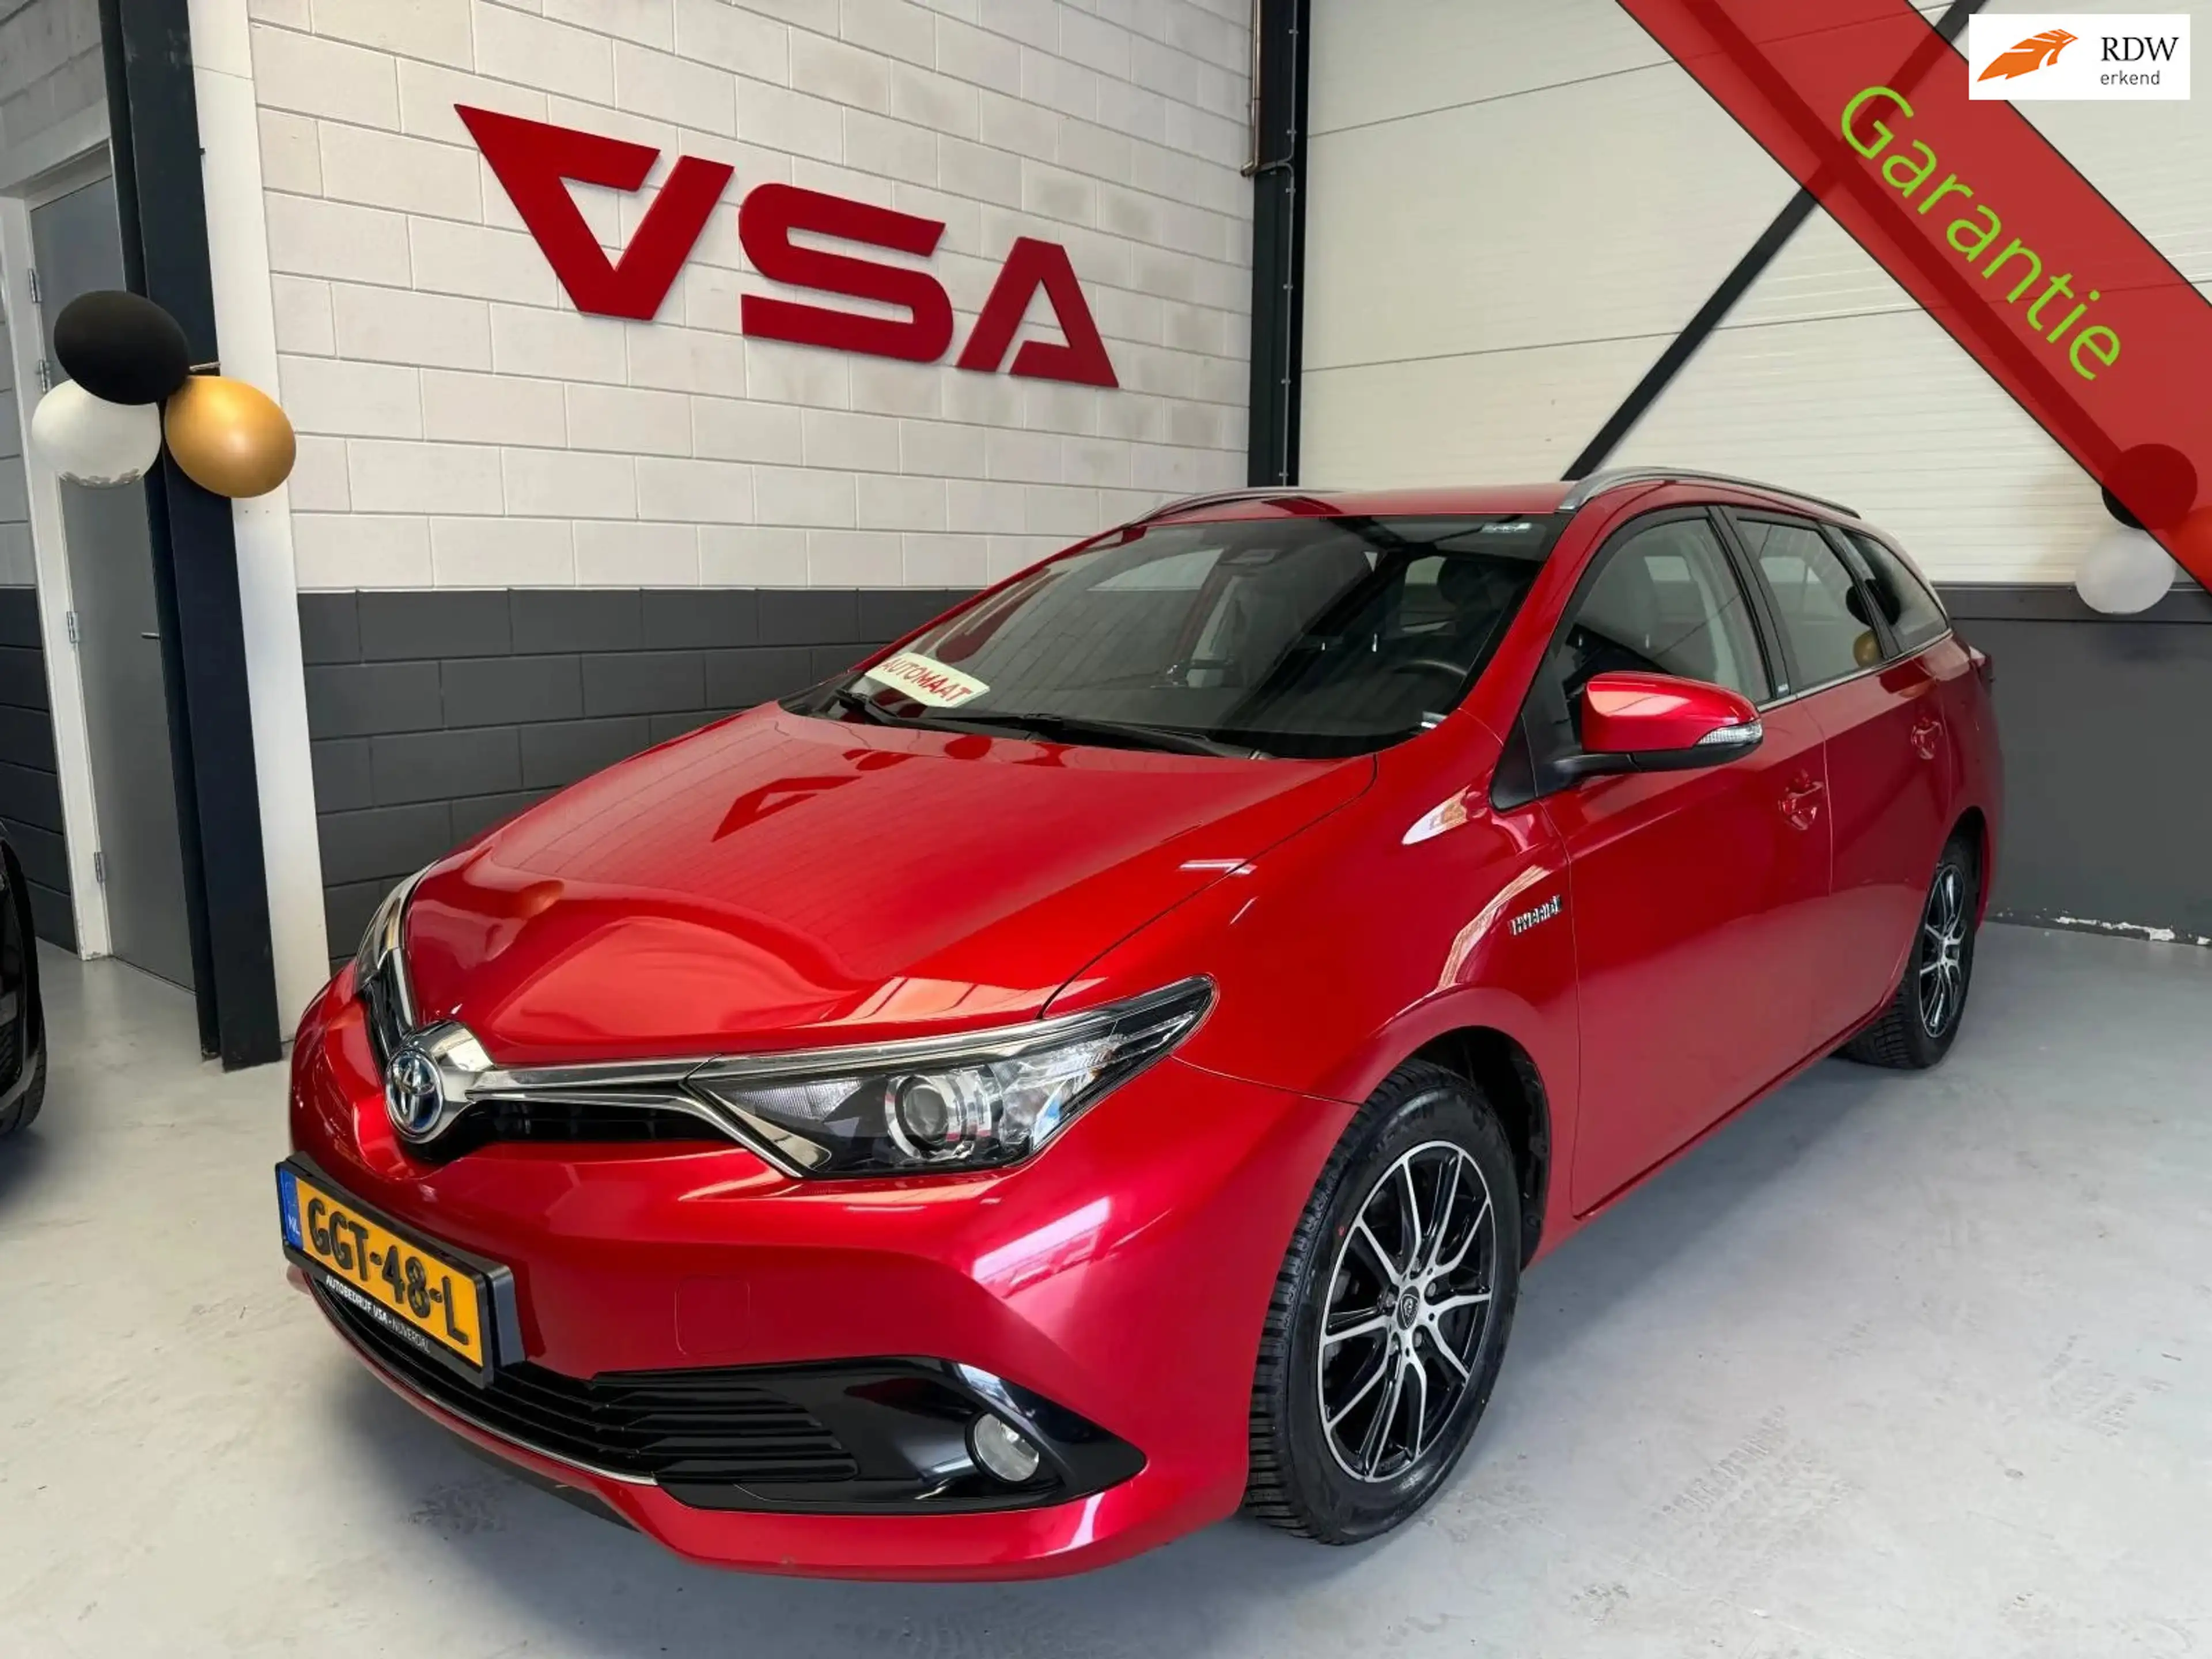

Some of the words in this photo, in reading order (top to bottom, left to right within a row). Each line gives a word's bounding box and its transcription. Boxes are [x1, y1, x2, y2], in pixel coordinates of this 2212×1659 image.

[453, 103, 1119, 388] VSA
[880, 658, 972, 702] AUTOMAAT
[308, 1196, 469, 1346] GGT-48-L
